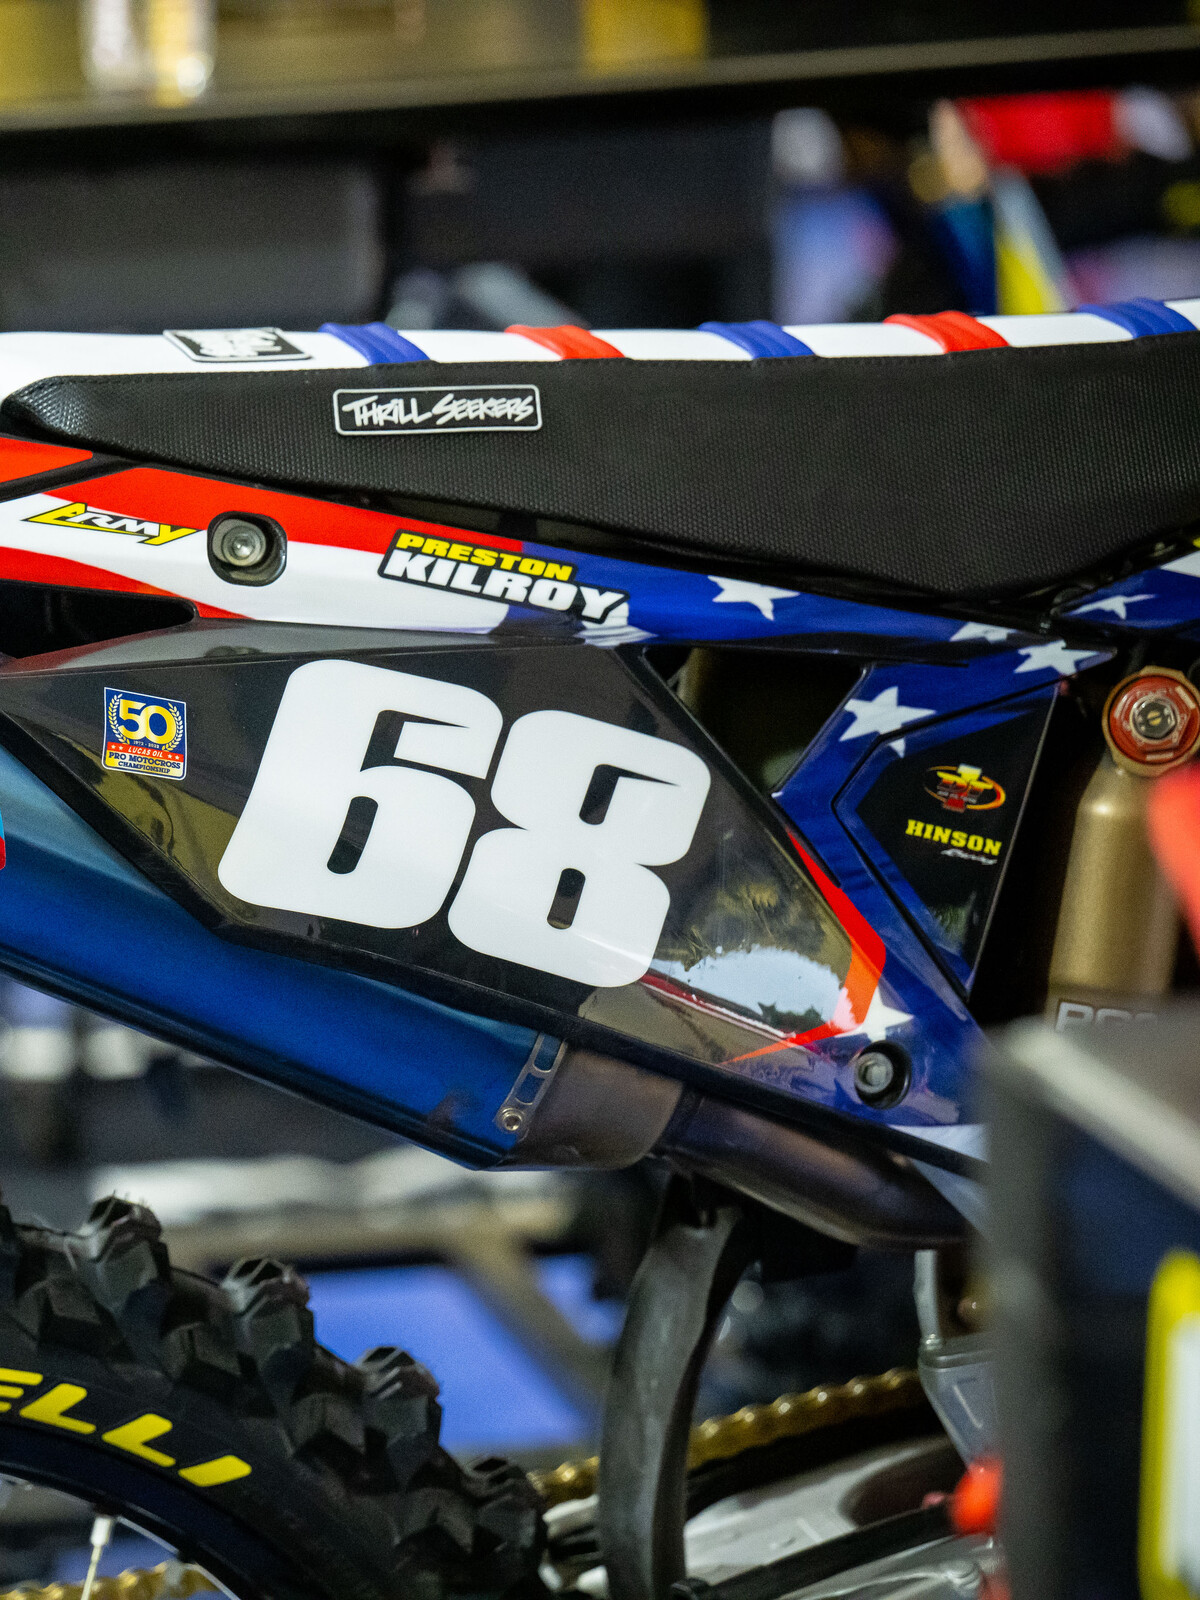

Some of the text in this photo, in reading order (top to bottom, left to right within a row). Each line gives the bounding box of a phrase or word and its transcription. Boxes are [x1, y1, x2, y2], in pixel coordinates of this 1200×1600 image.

[341, 393, 534, 426] THRILL SEEKERS
[395, 532, 573, 581] PRESTON
[383, 549, 626, 619] KILROY
[118, 698, 177, 745] 50
[108, 751, 181, 769] PRO MOTOCROSS
[118, 761, 171, 773] CHAMPIONSHIP
[128, 746, 163, 758] LUCAS OIL
[218, 659, 711, 988] 68
[905, 819, 1002, 856] HINSON
